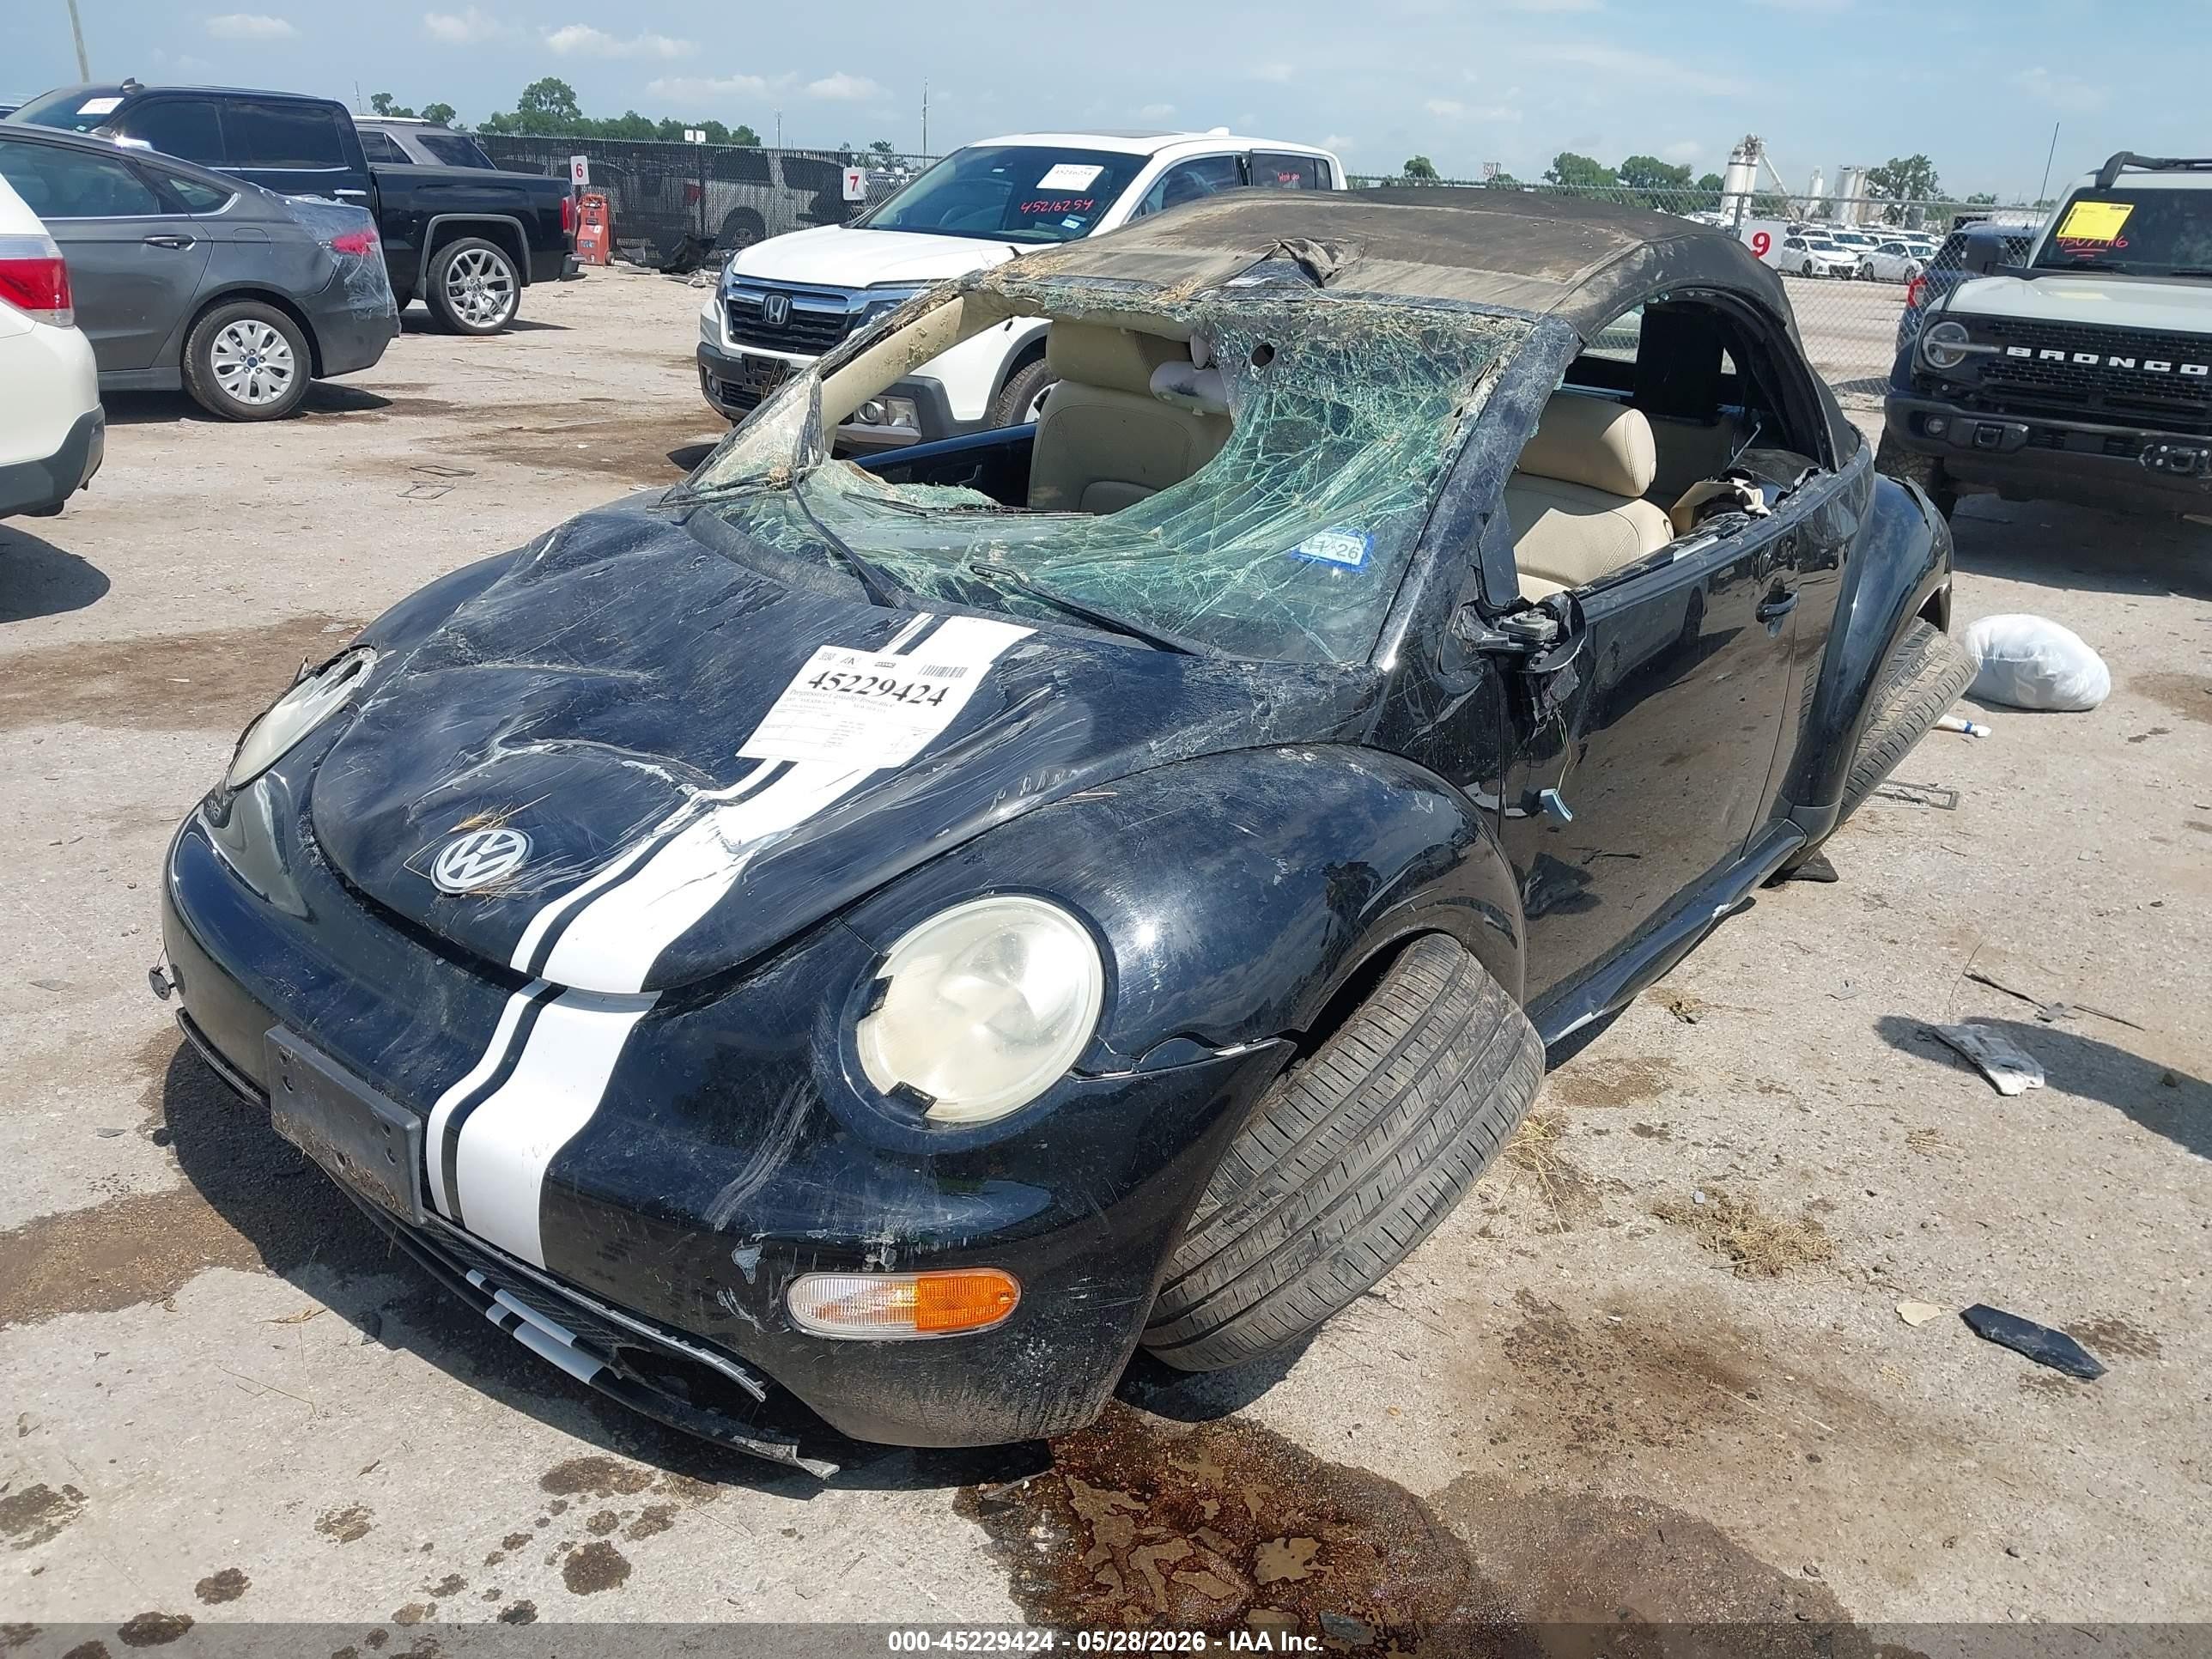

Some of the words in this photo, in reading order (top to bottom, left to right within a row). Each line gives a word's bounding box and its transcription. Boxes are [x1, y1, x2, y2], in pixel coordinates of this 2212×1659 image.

[575, 163, 584, 178] 6
[849, 175, 860, 192] 7
[1020, 198, 1094, 214] 45216254
[1753, 232, 1771, 260] 9
[2006, 345, 2209, 376] BRONCO
[1336, 543, 1360, 560] 26
[807, 670, 950, 707] 45229424
